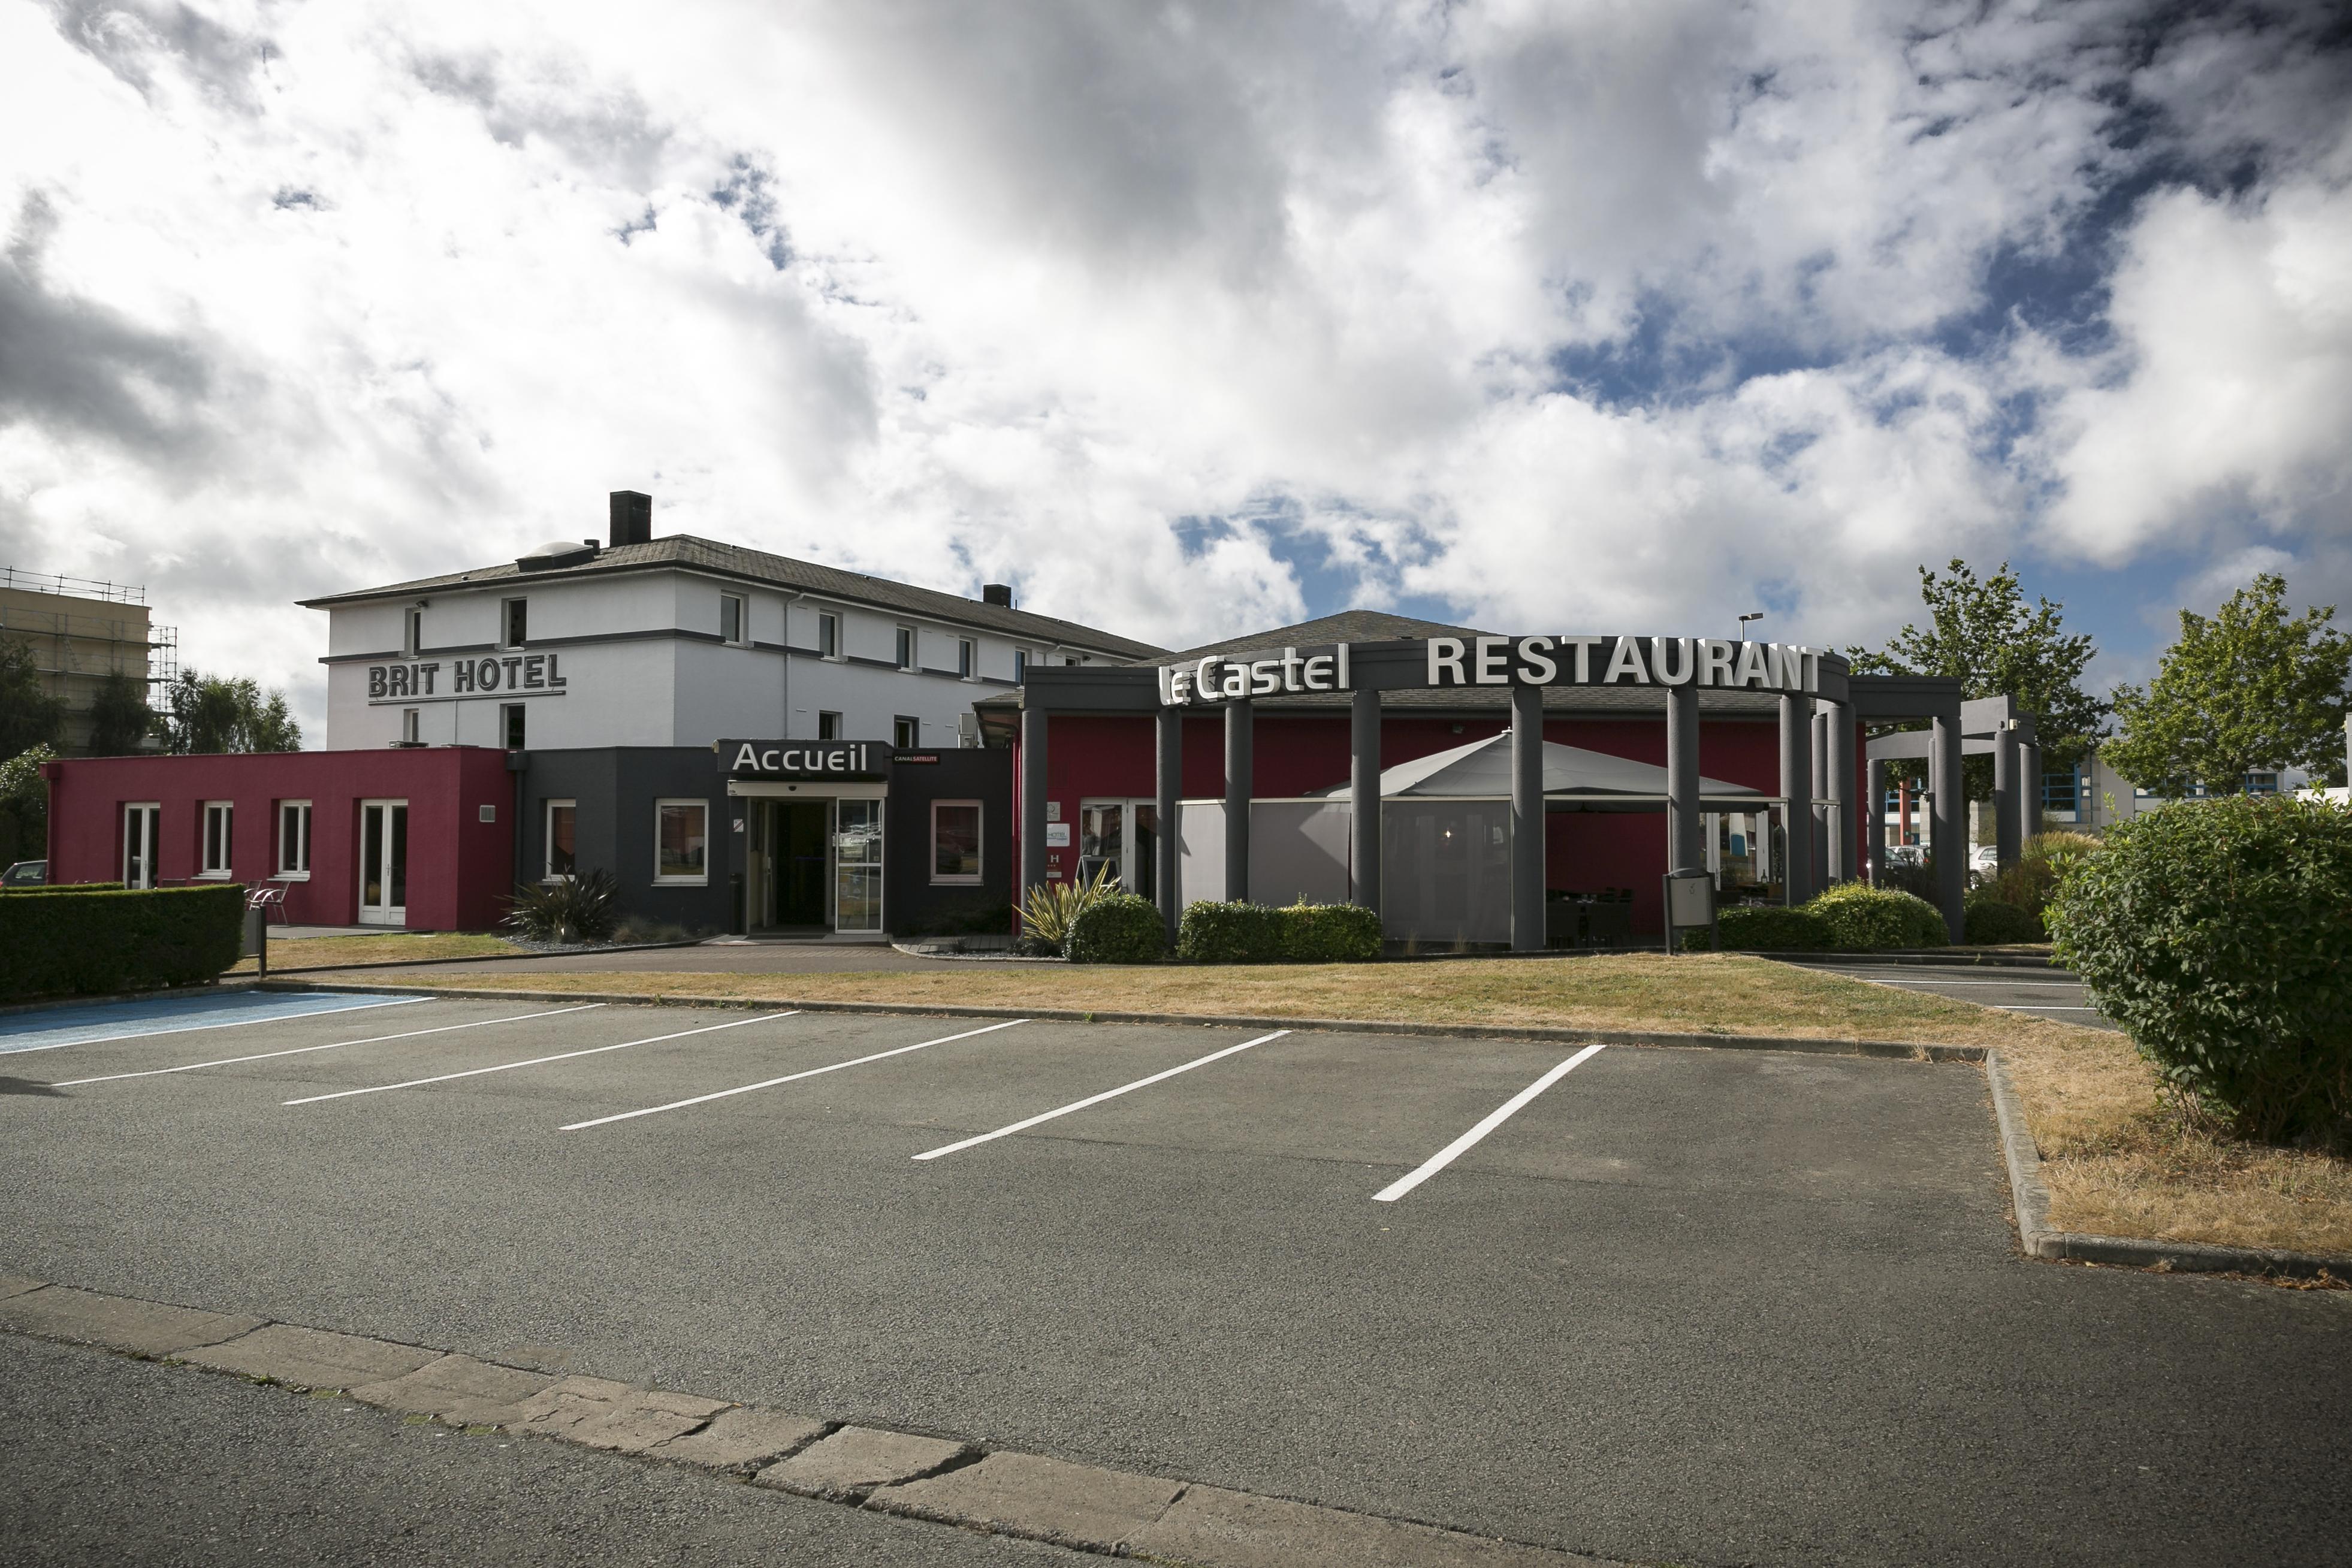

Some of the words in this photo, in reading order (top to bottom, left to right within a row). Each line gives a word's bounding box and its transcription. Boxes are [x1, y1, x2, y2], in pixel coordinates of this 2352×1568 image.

[369, 662, 439, 698] BRIT
[454, 653, 567, 693] HOTEL
[1197, 643, 1349, 700] Castel
[1427, 635, 1825, 693] RESTAURANT
[732, 743, 867, 772] Accueil
[1050, 854, 1059, 863] H
